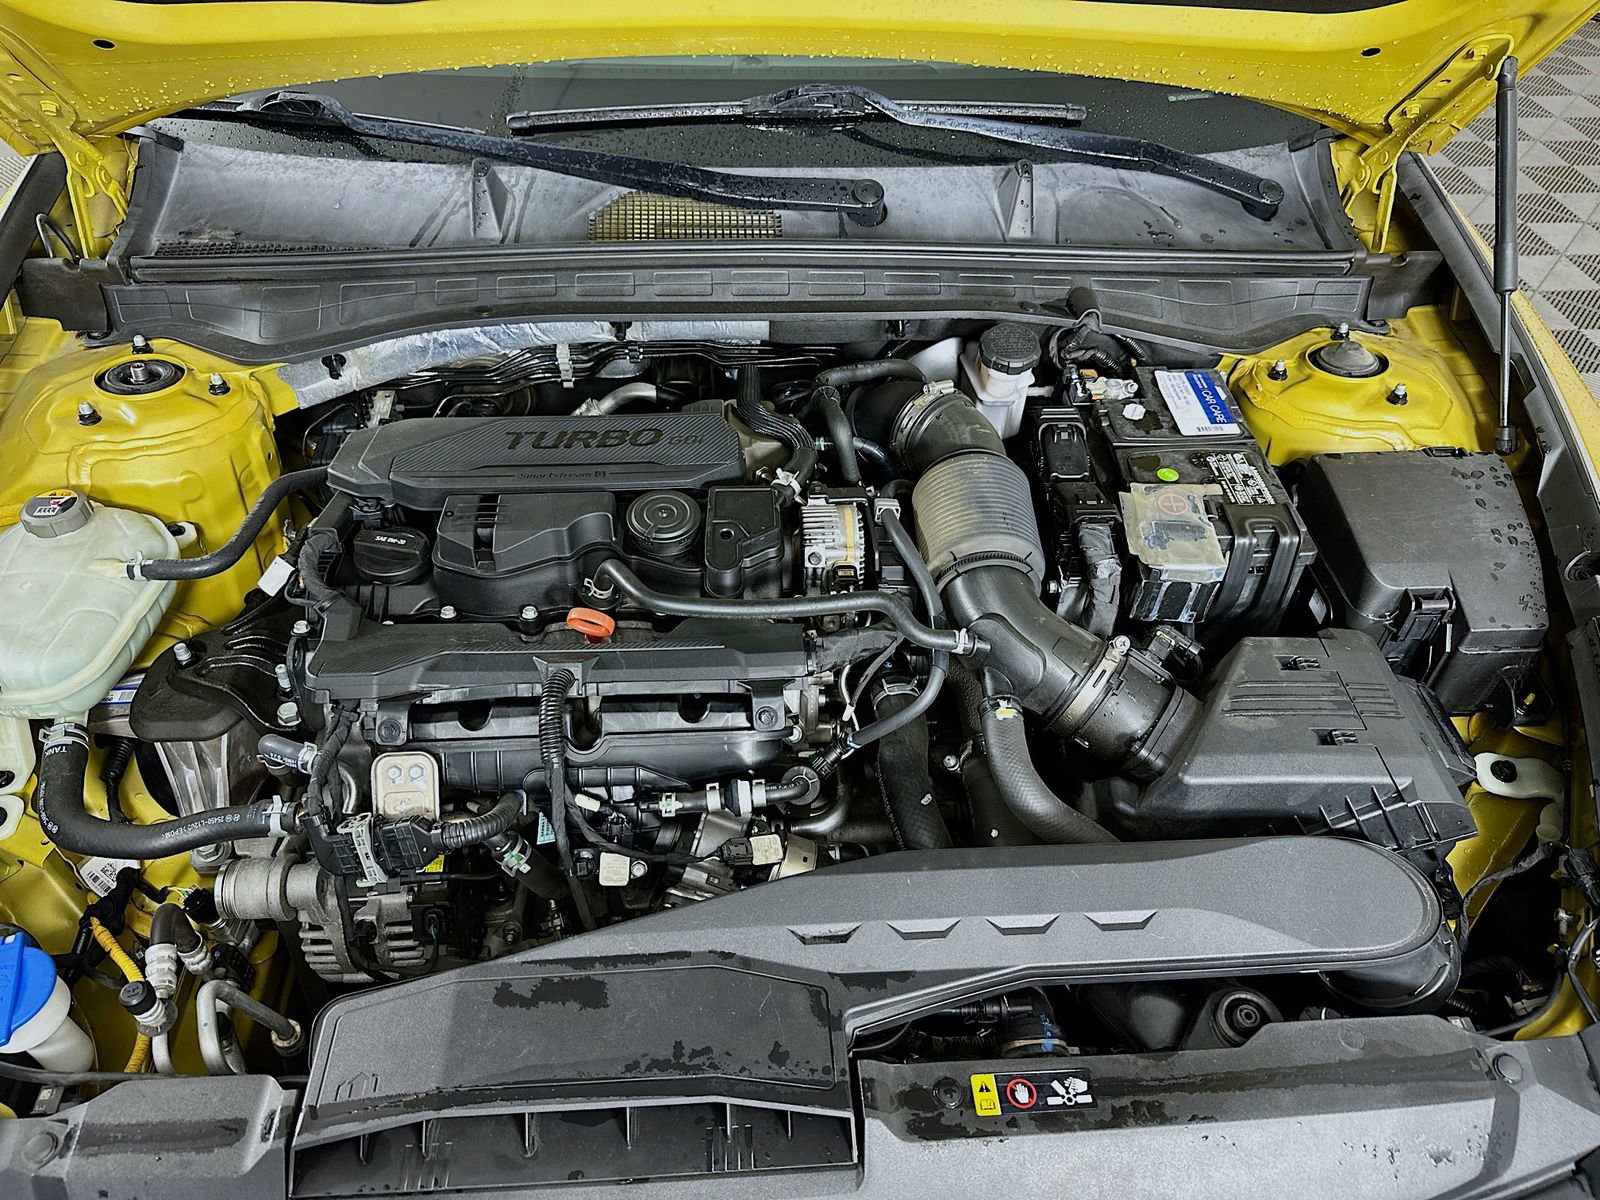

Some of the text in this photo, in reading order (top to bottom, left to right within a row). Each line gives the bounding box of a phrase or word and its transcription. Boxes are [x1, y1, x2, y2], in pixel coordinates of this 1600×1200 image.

[1202, 390, 1227, 423] CAR CARE
[505, 428, 664, 450] TURBO
[520, 471, 592, 479] Smartstream
[44, 745, 68, 758] TANK
